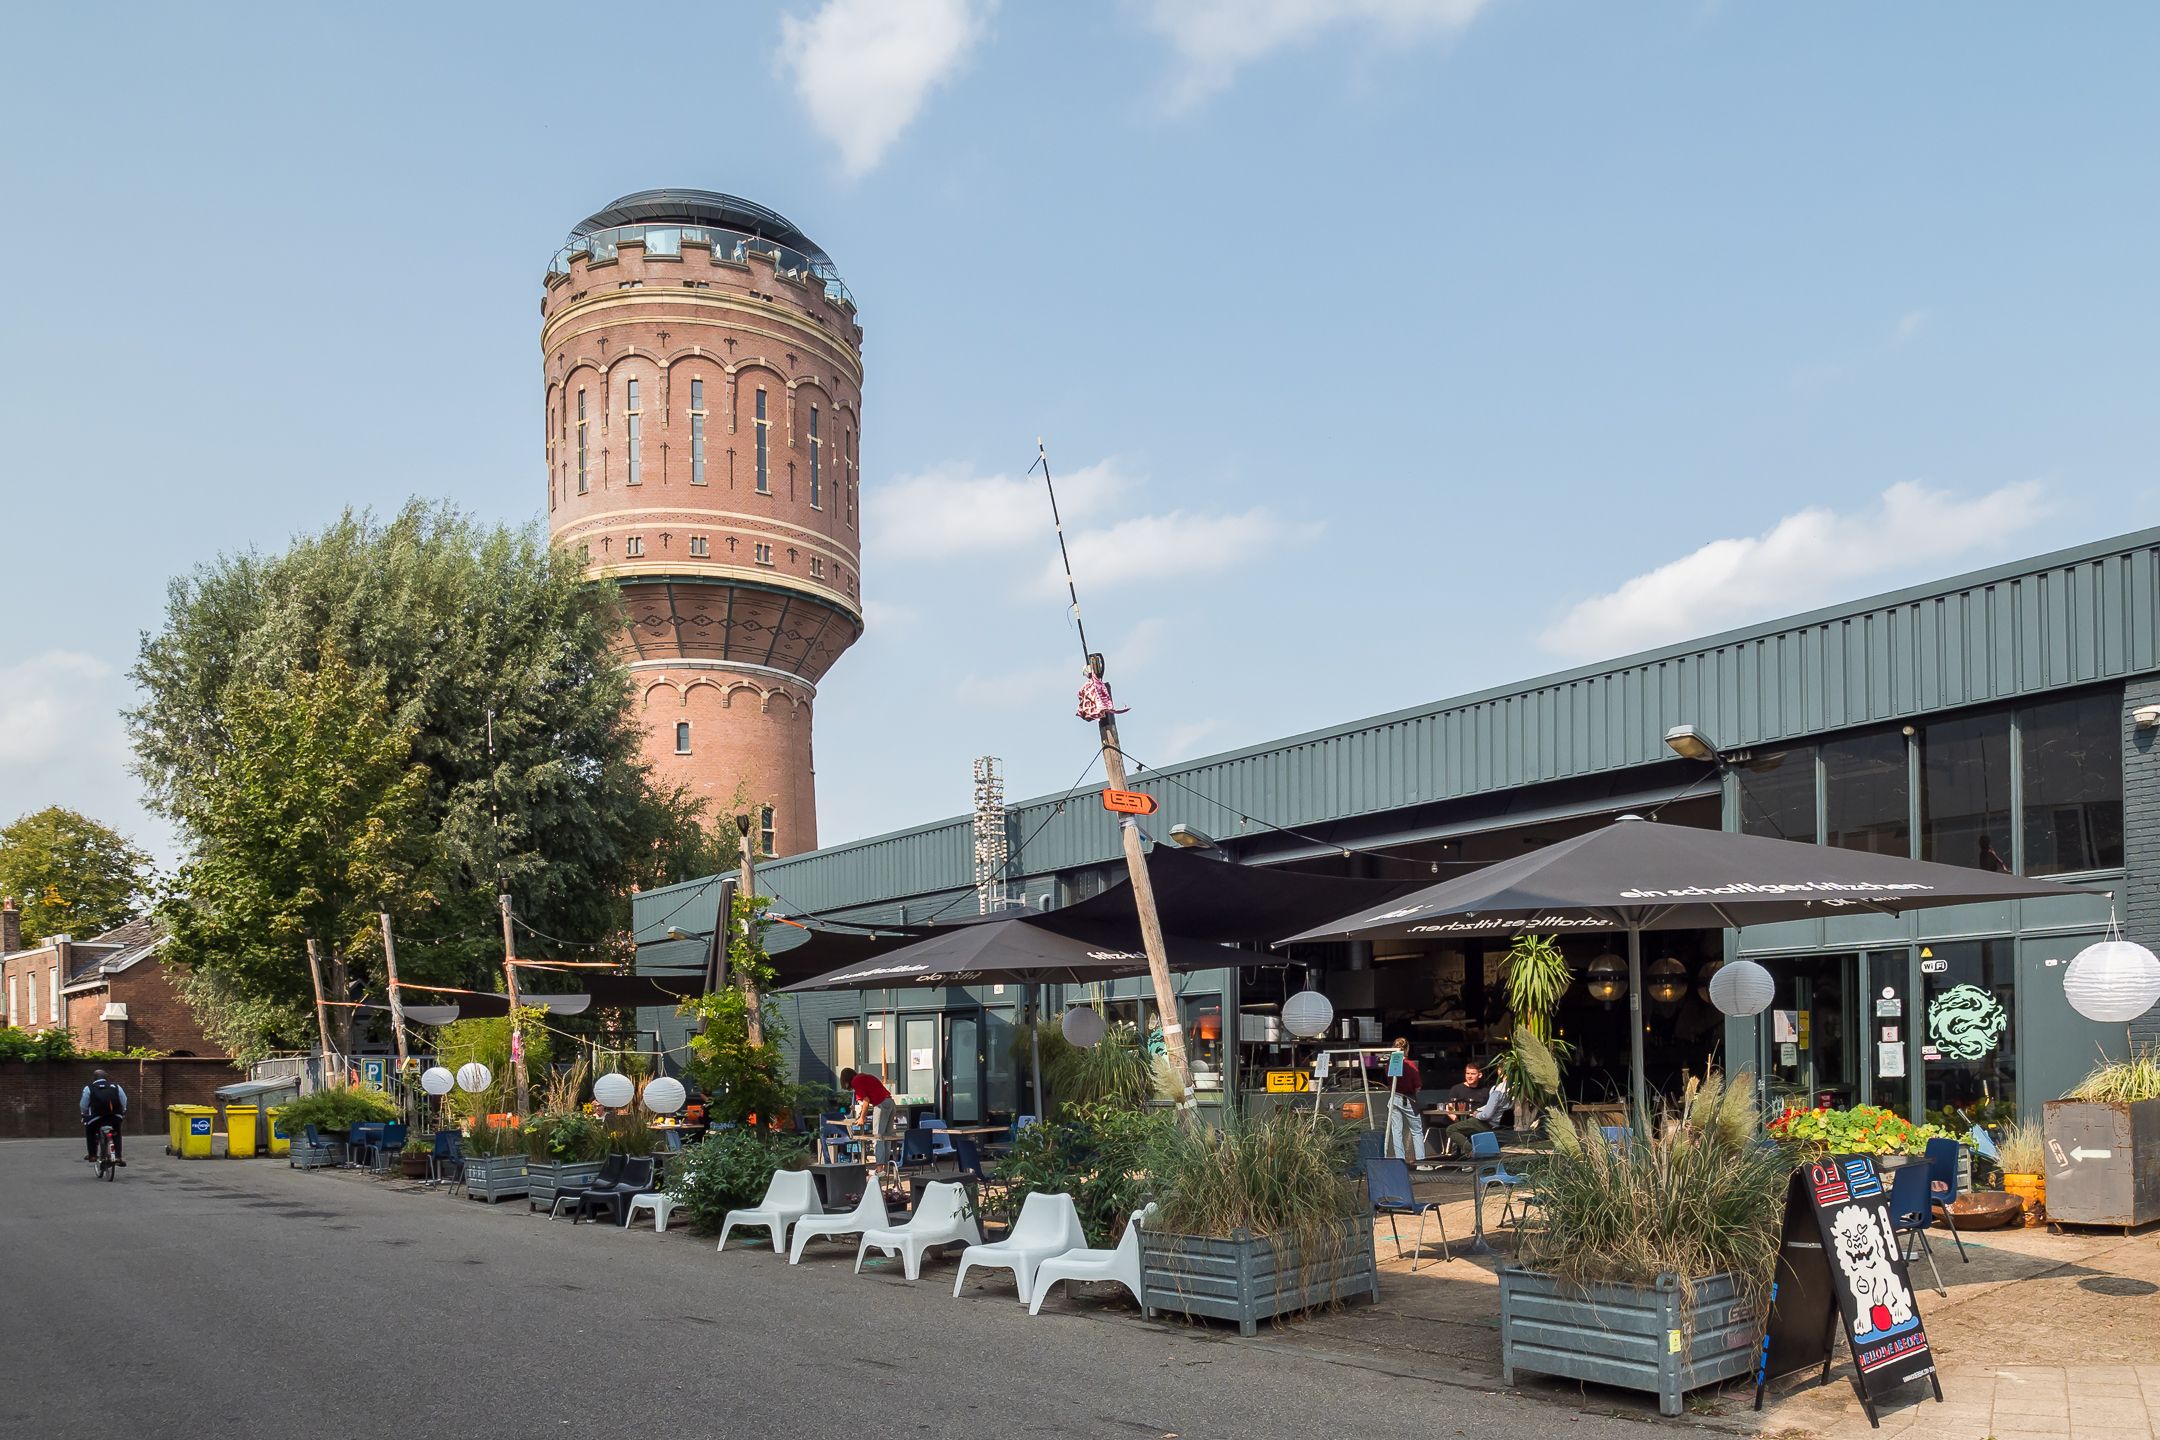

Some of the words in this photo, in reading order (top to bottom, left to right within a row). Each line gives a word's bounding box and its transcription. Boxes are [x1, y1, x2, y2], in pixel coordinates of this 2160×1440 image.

[1619, 888, 1668, 898] ein
[1667, 883, 1813, 897] schattiges
[368, 1063, 379, 1081] P
